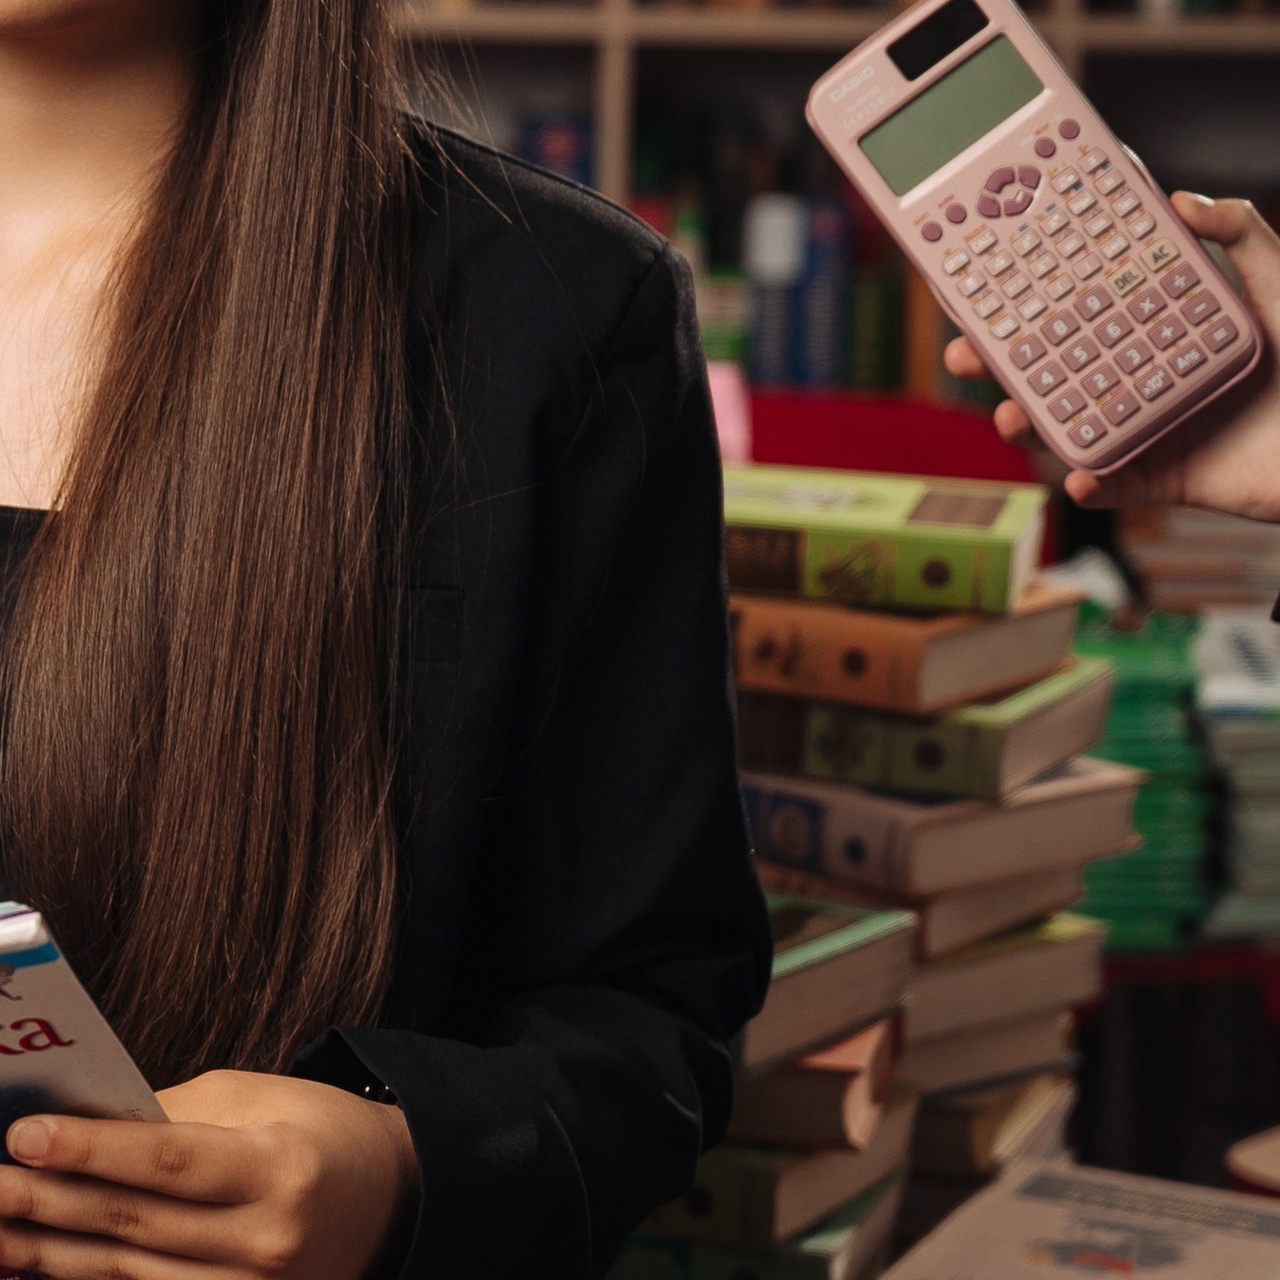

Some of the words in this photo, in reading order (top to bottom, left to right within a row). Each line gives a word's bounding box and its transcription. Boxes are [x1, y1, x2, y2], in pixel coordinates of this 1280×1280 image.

[827, 65, 876, 103] CASIO
[1019, 343, 1034, 359] 7
[1051, 318, 1069, 337] 8
[1085, 294, 1102, 312] 9
[1112, 266, 1139, 290] DEL
[1148, 243, 1171, 265] AC
[1037, 369, 1056, 388] 4
[1071, 345, 1089, 363] 5
[1105, 320, 1122, 339] 6
[1059, 397, 1074, 413] 1
[1091, 371, 1109, 390] 2
[1126, 347, 1143, 365] 3
[1078, 422, 1097, 442] 0
[1174, 346, 1202, 370] Ans
